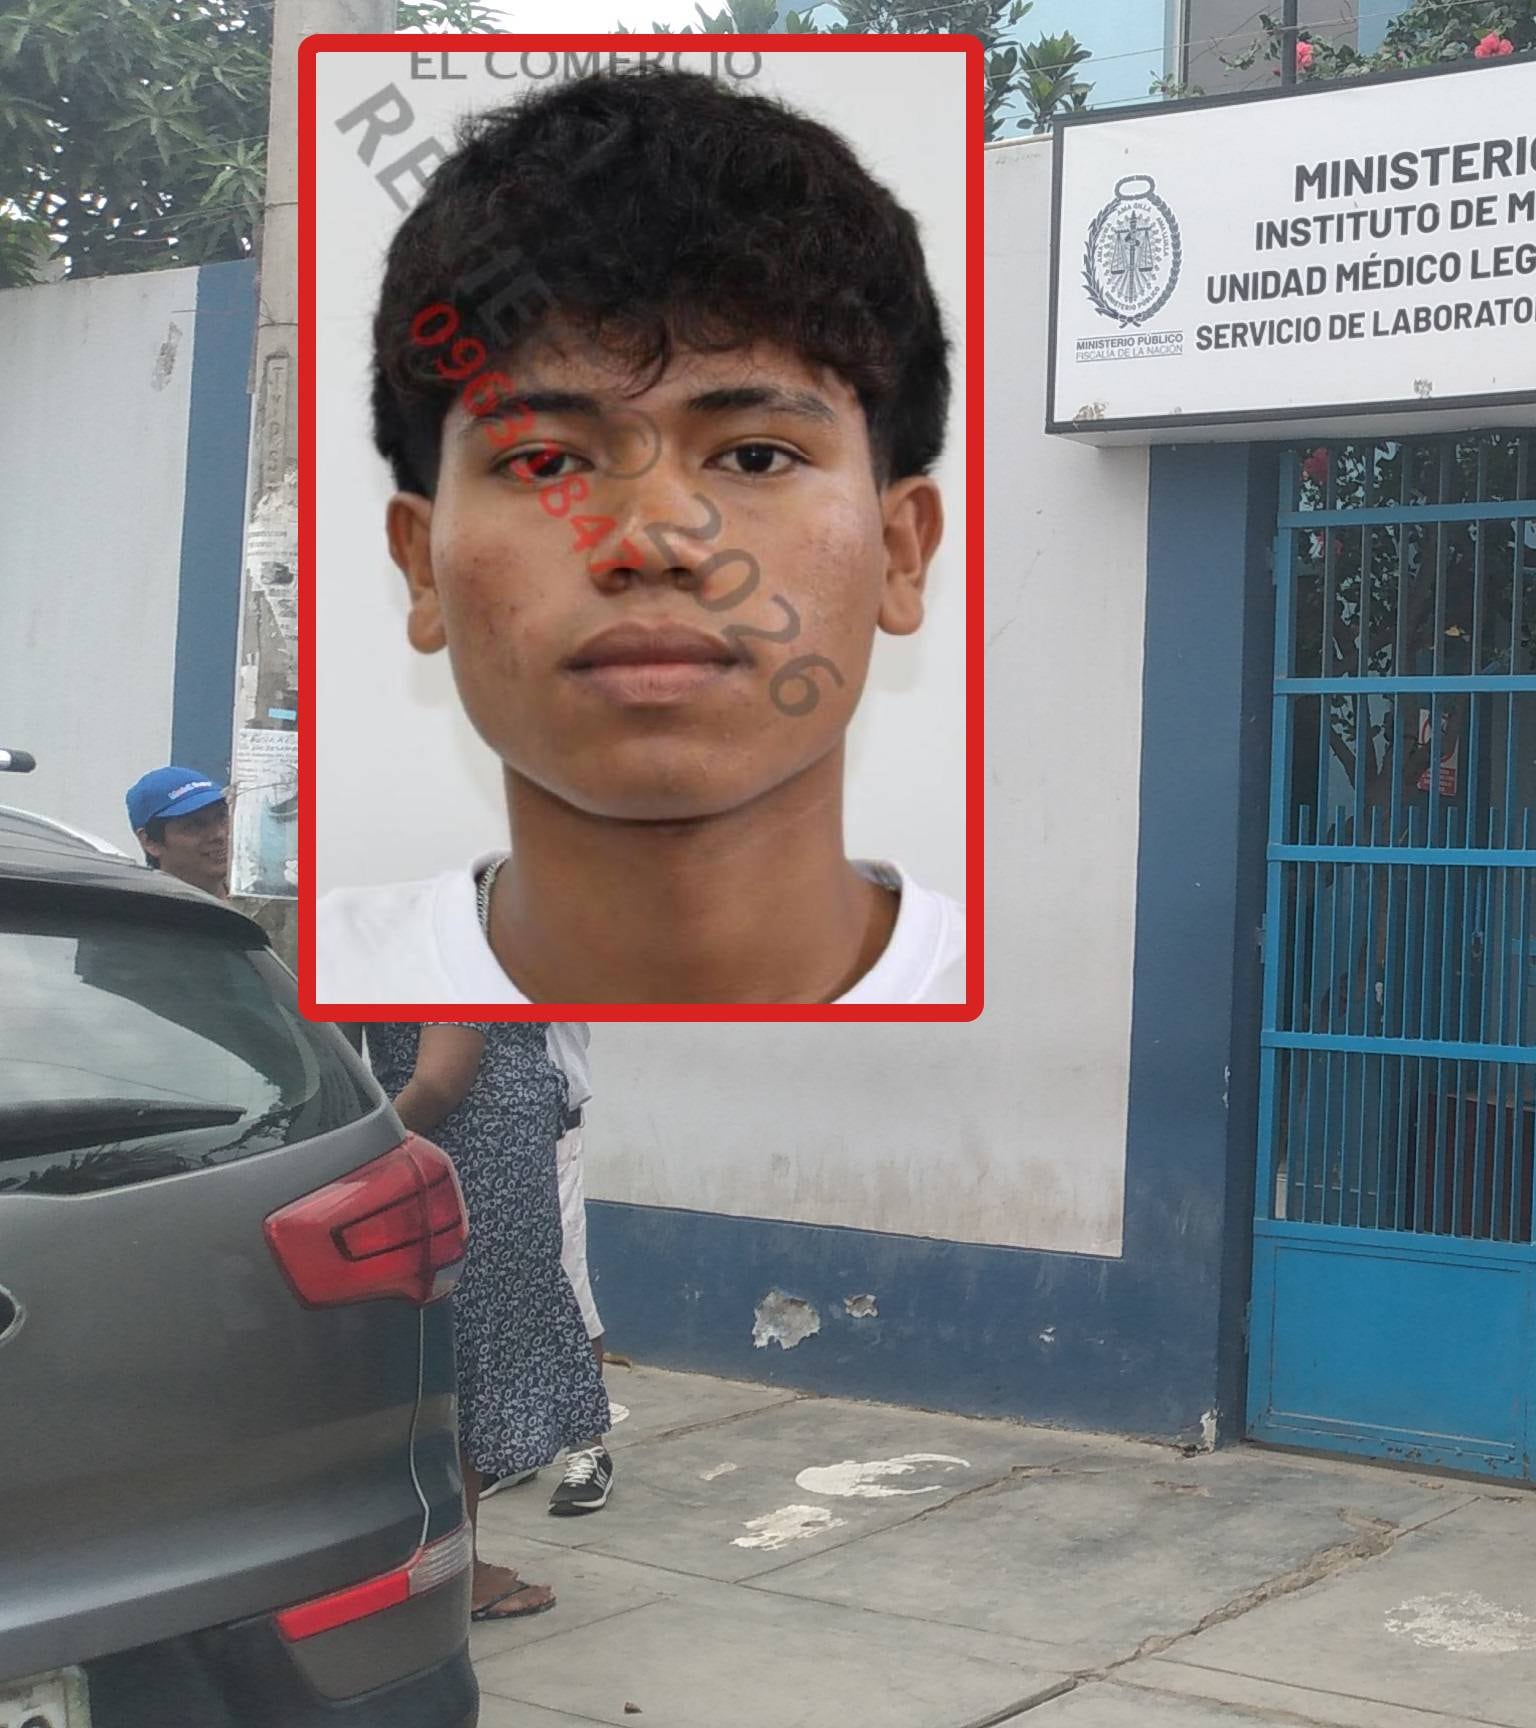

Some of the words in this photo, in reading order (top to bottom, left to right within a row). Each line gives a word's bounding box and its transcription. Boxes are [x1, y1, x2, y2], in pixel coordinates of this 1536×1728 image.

[1255, 202, 1440, 251] INSTITUTO
[1450, 195, 1498, 230] DE
[1207, 266, 1327, 304] UNIDAD
[1336, 252, 1461, 293] MÉDICO
[1076, 337, 1135, 351] MINISTERIO
[1137, 332, 1184, 347] PÚBLICO
[1196, 316, 1321, 351] SERVICIO
[1329, 312, 1365, 340] DE
[1118, 348, 1131, 358] DE
[1133, 347, 1144, 357] LA
